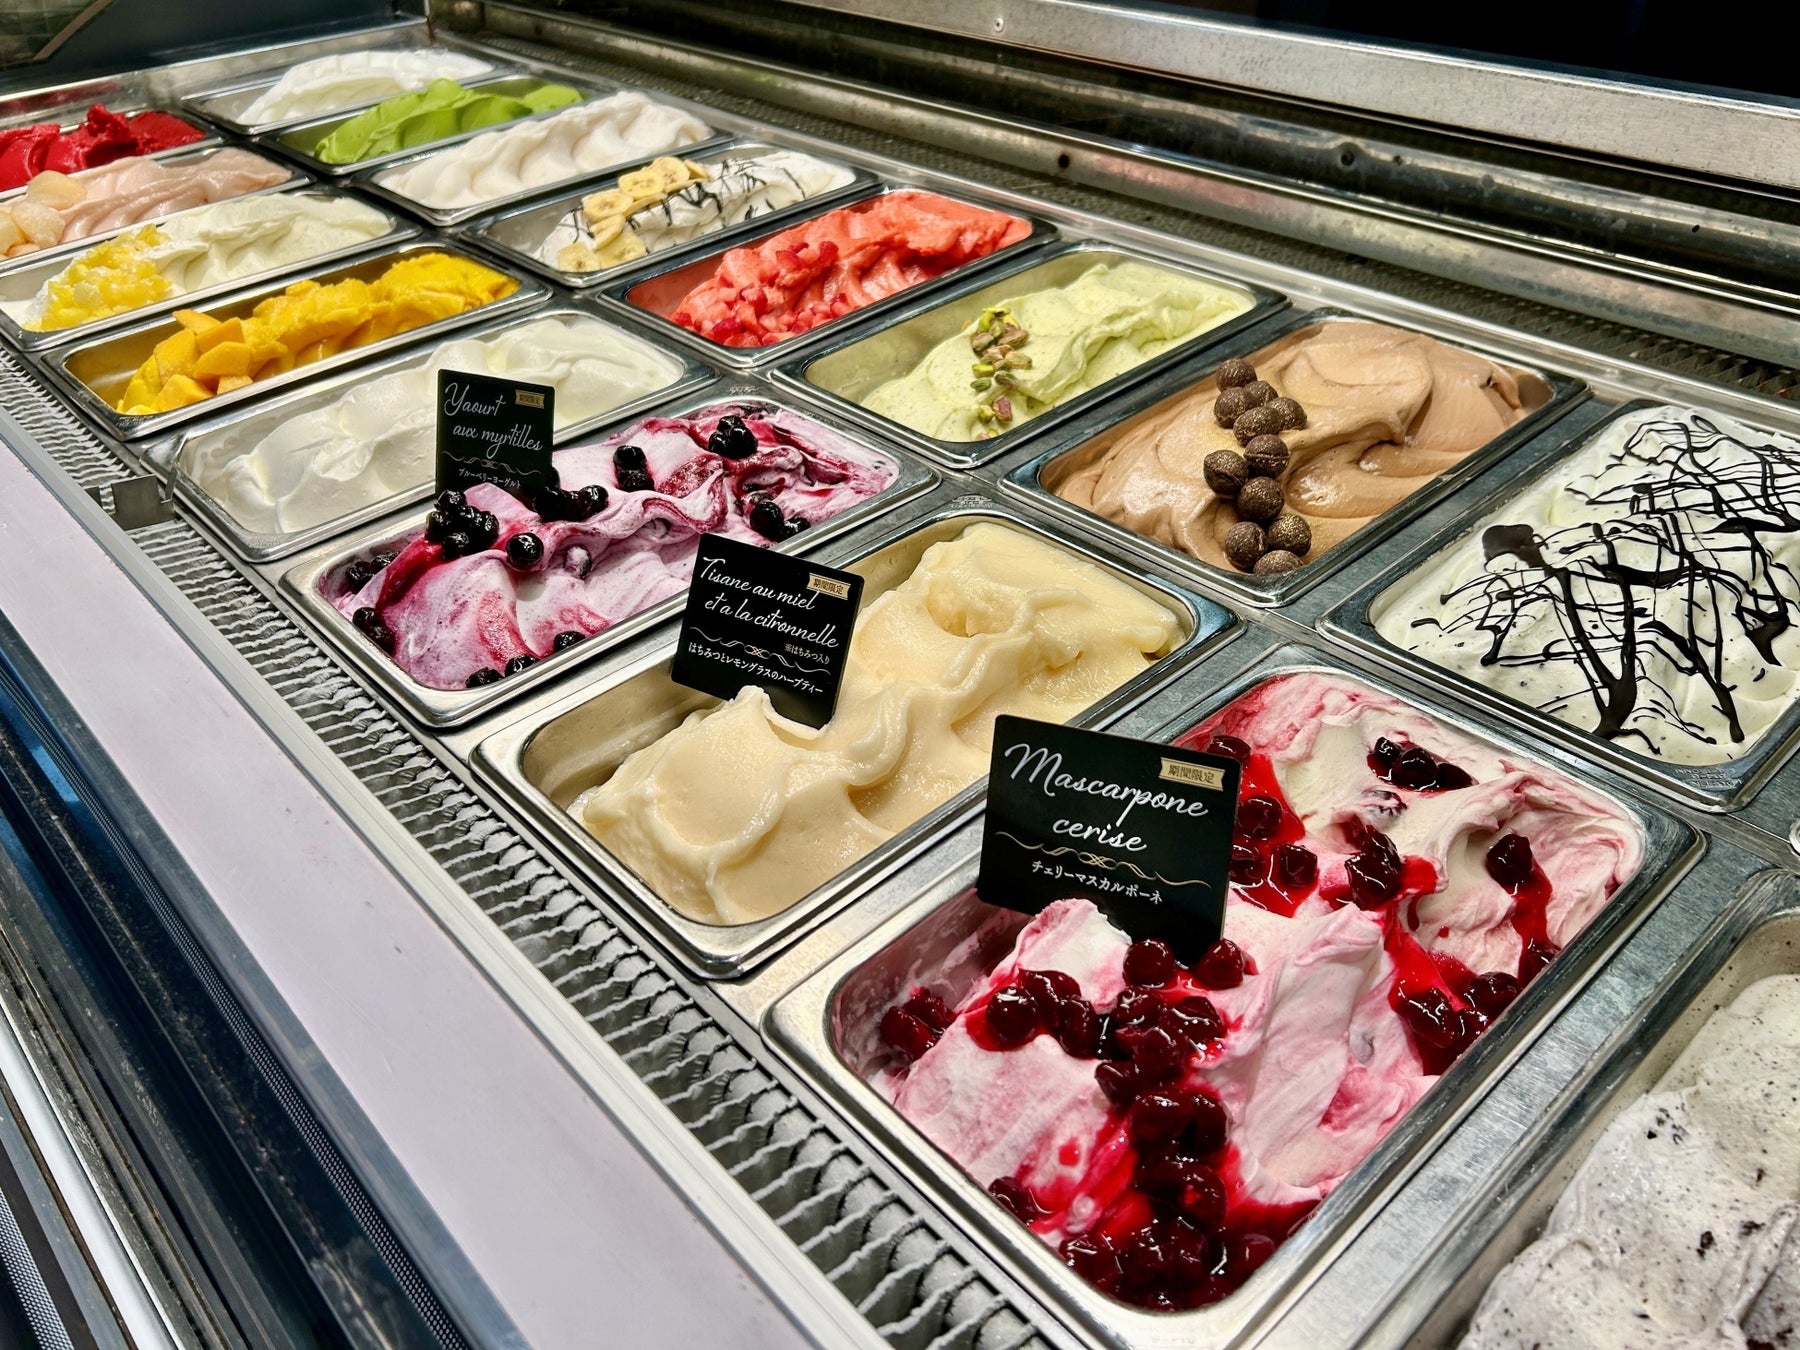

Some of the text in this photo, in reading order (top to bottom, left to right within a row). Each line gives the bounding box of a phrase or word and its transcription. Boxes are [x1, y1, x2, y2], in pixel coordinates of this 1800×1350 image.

[444, 382, 507, 416] Yaourt
[453, 424, 543, 459] aux myrtilles
[700, 556, 820, 610] Tisane au miel
[812, 578, 844, 595] 期間限定
[705, 592, 727, 611] et
[734, 599, 753, 622] la
[753, 609, 839, 648] citronnelle
[688, 642, 823, 694] はちみつとレモングラスのハーブティー
[1004, 743, 1209, 827] Mascarpone
[1167, 763, 1215, 785] 期間限定
[1052, 818, 1148, 851] cerise
[1032, 860, 1163, 905] チェリーマスカルポーネ
